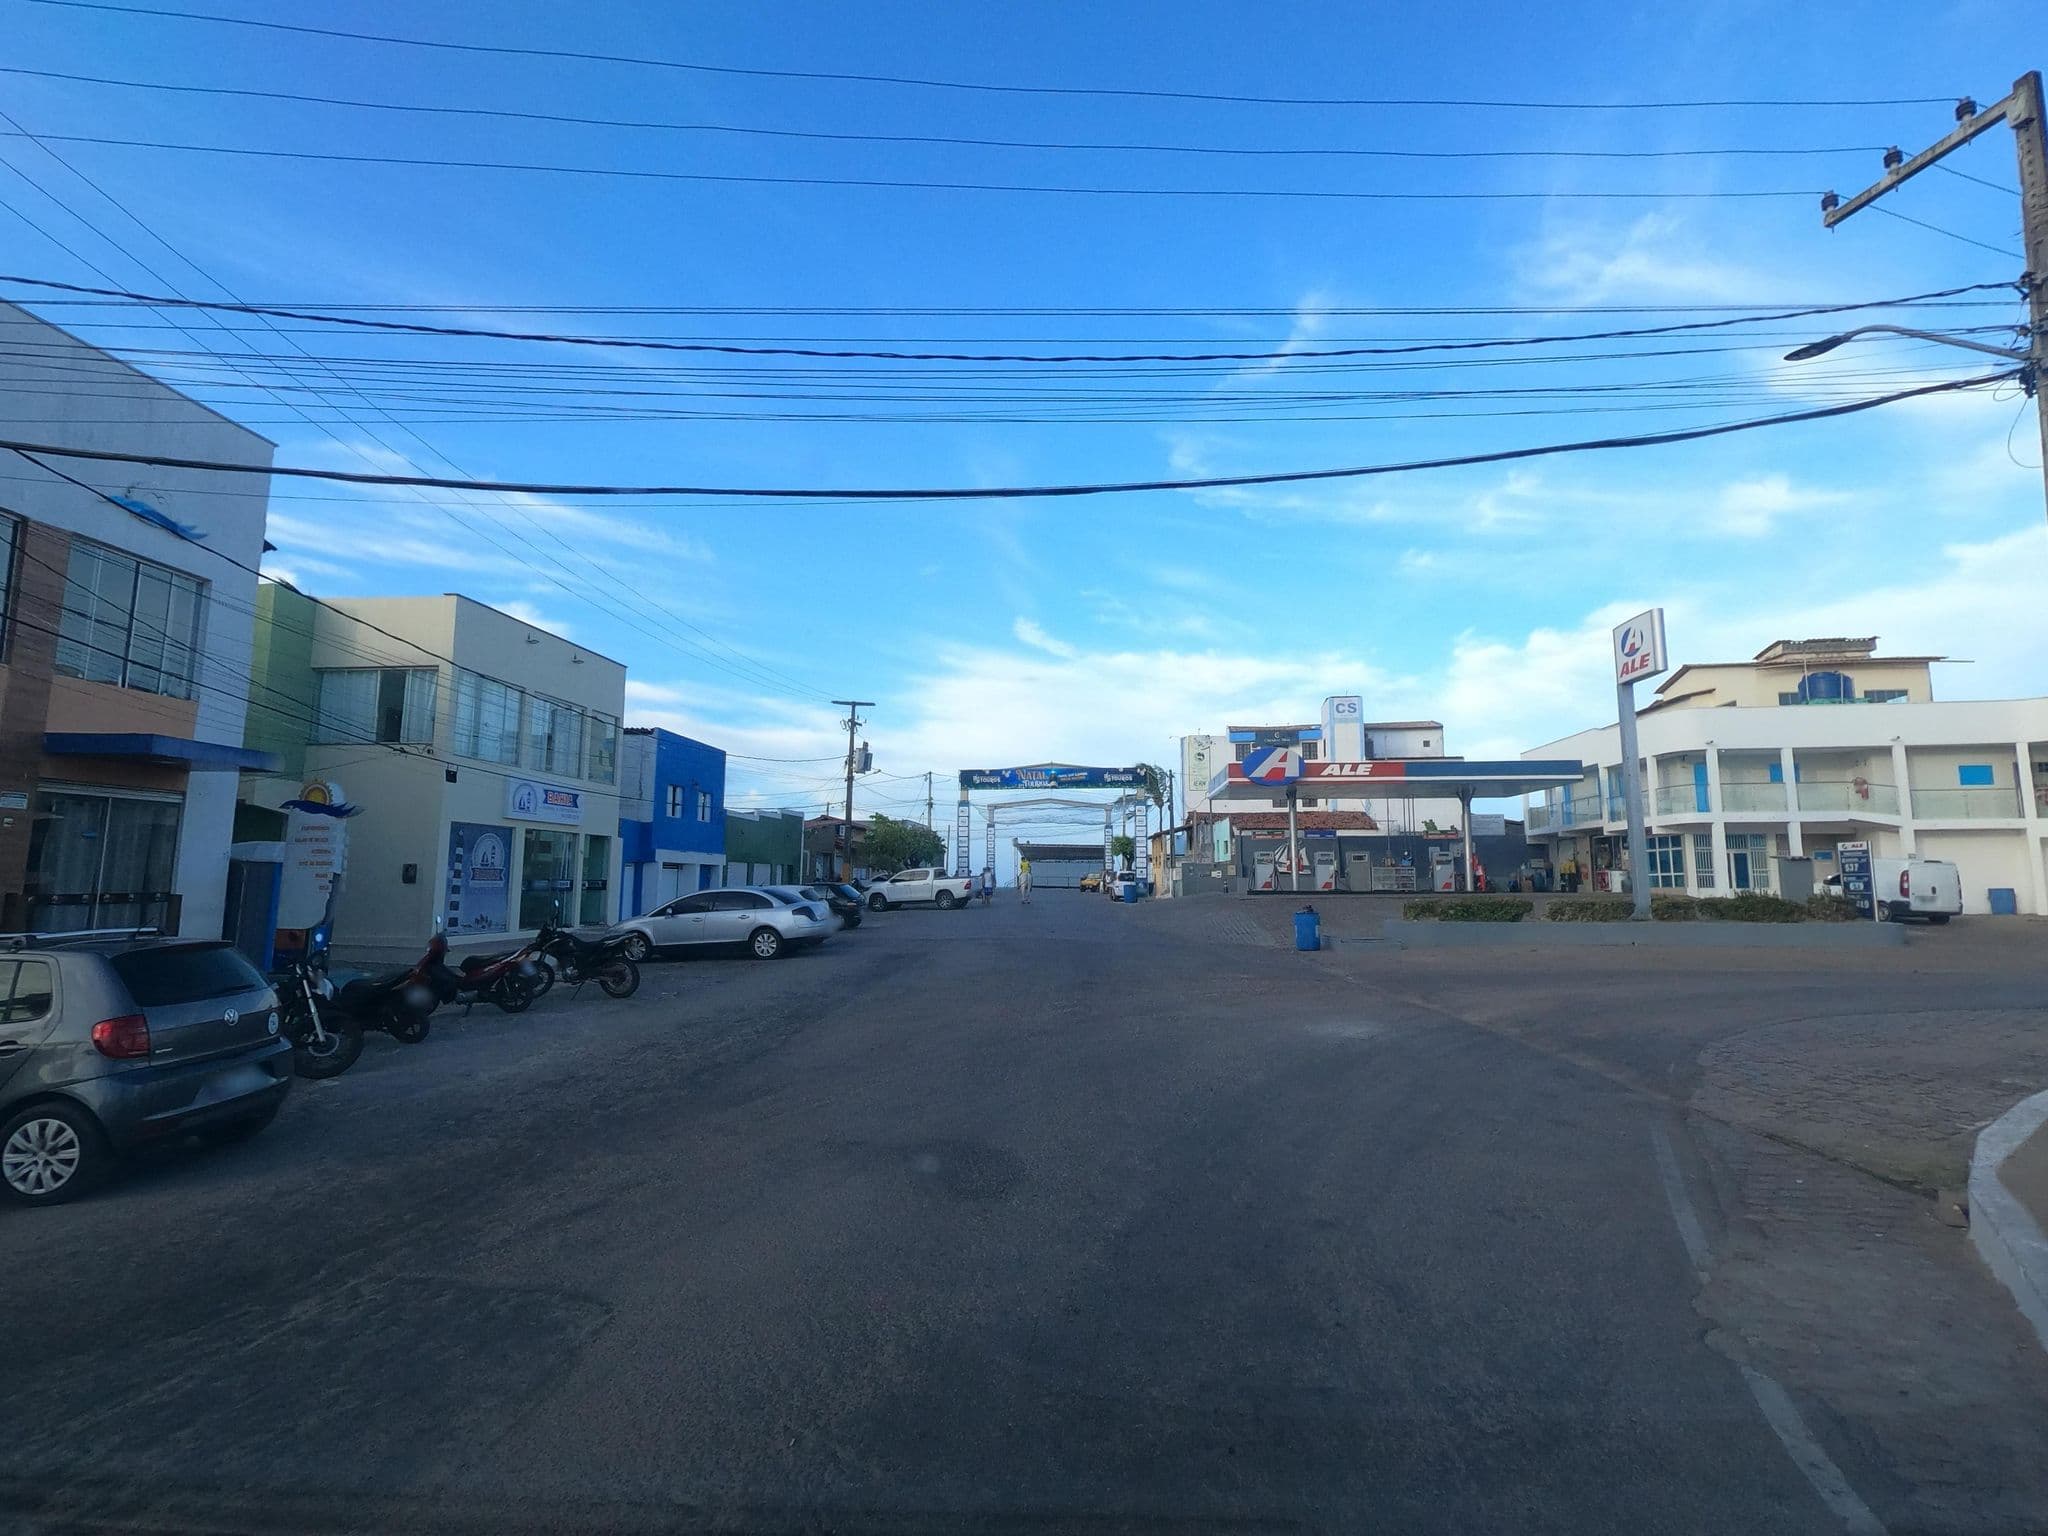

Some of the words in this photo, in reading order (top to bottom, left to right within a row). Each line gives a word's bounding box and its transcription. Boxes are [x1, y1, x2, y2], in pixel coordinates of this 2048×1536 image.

[1620, 652, 1651, 678] ALE
[1335, 703, 1357, 713] CS
[1320, 763, 1374, 776] ALE
